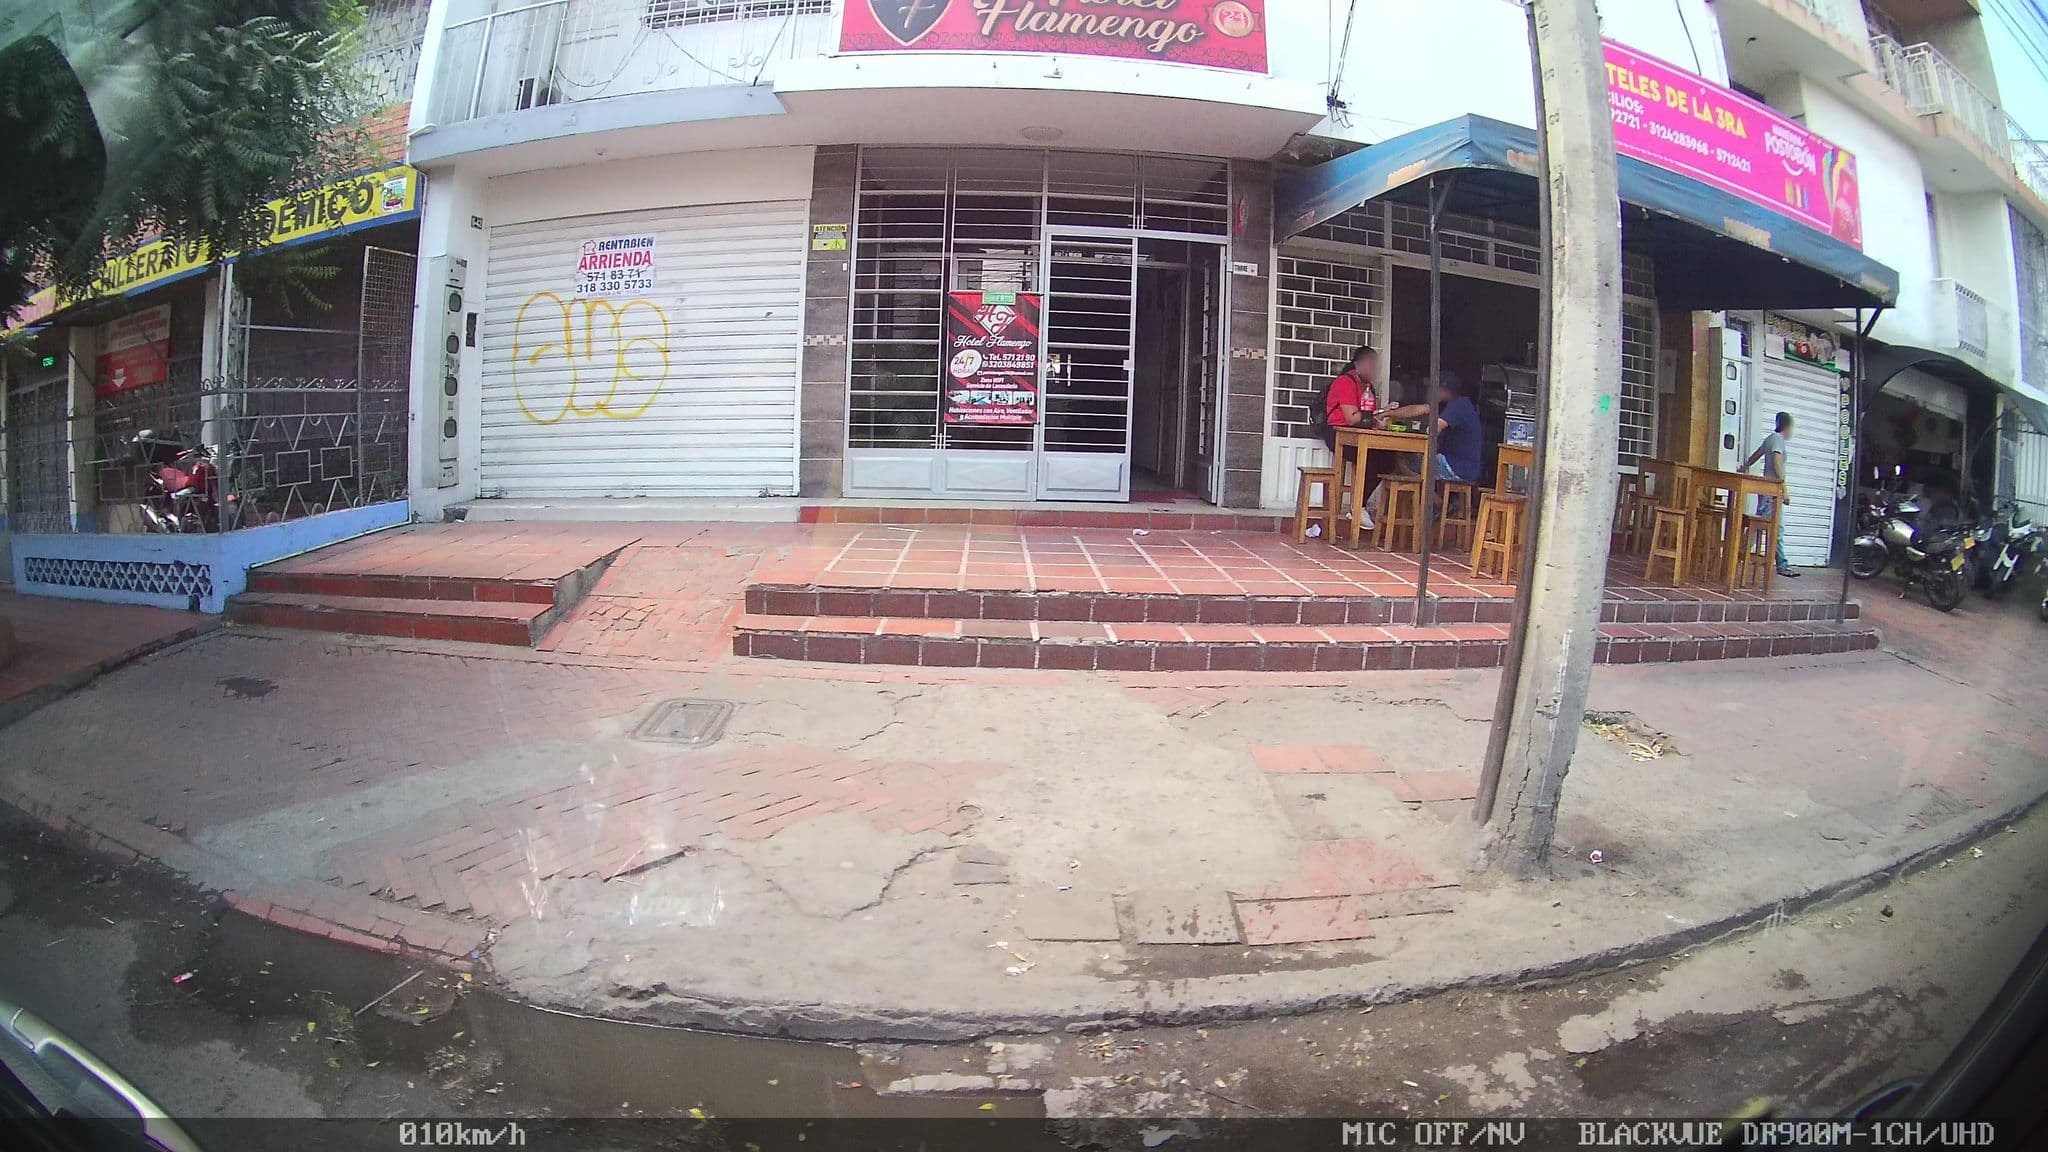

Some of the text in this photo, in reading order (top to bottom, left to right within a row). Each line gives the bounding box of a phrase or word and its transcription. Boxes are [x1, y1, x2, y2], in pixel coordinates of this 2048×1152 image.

[976, 0, 1205, 53] Flamengo
[1665, 85, 1688, 114] DE
[1692, 96, 1714, 124] LA
[1715, 106, 1748, 139] 3RA
[598, 237, 654, 252] RENTABIEN
[578, 250, 653, 271] ARRIENDA
[586, 268, 641, 283] 571 83 71
[576, 279, 652, 293] 318 330 5733
[953, 335, 1032, 350] Hotel Flamengo
